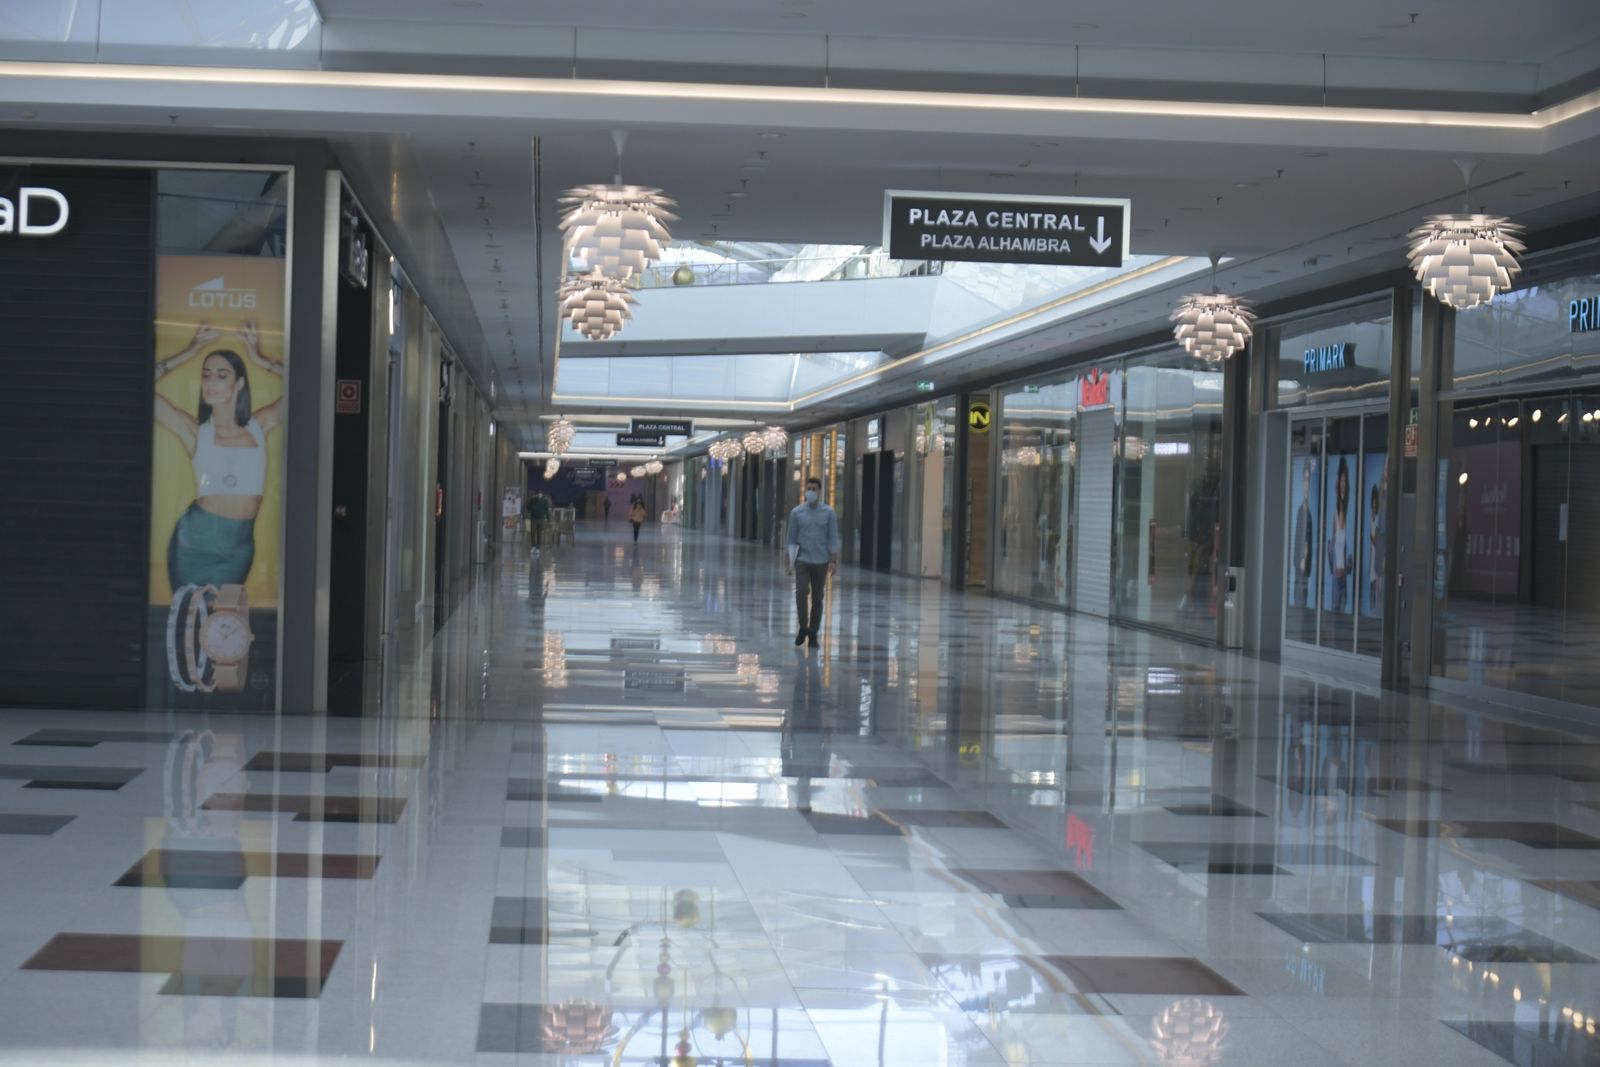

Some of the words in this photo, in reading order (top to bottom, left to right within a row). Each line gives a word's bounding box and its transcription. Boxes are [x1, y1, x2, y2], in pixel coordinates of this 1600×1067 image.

[909, 208, 978, 227] PLAZA
[986, 212, 1085, 230] CENTRAL
[921, 233, 975, 248] PLAZA
[978, 236, 1071, 252] ALHAMBRA
[189, 292, 256, 309] LOTUS
[1569, 295, 1600, 333] PRI
[1304, 343, 1345, 374] PRIMARK
